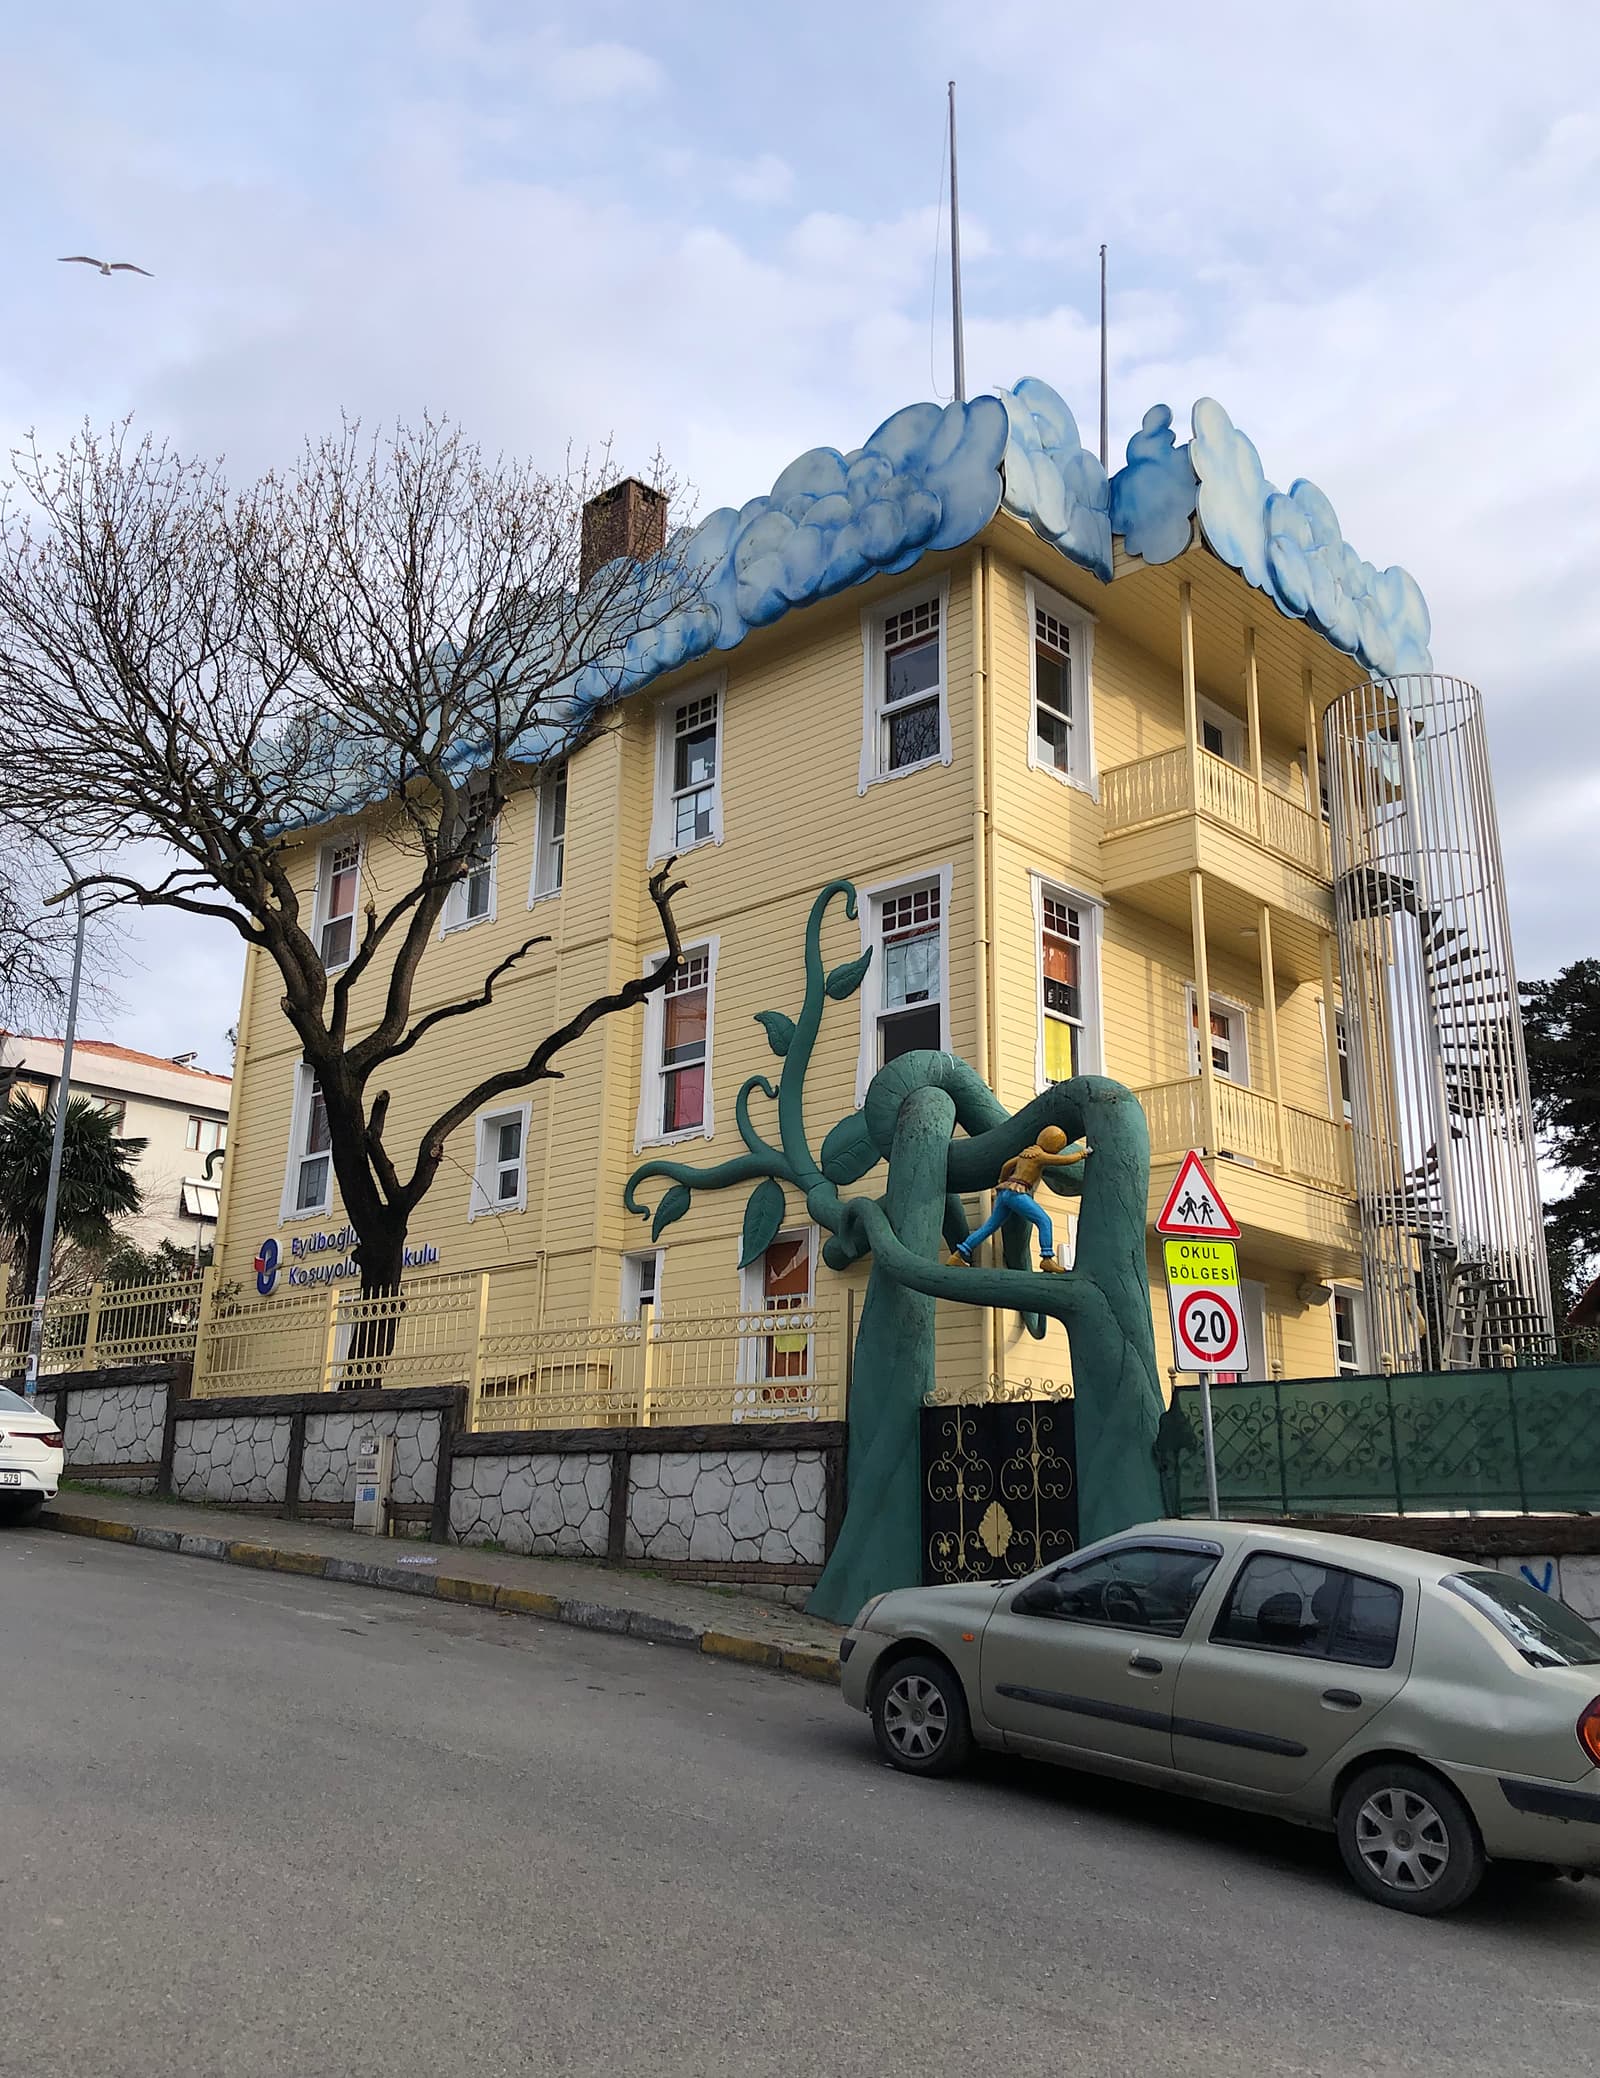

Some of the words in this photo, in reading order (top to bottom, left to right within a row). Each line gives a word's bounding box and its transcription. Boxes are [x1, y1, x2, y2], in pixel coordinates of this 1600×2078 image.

[403, 1243, 437, 1267] kulu
[1180, 1246, 1220, 1259] OKUL
[1170, 1264, 1235, 1281] BÖLGESİ
[1191, 1310, 1226, 1343] 20
